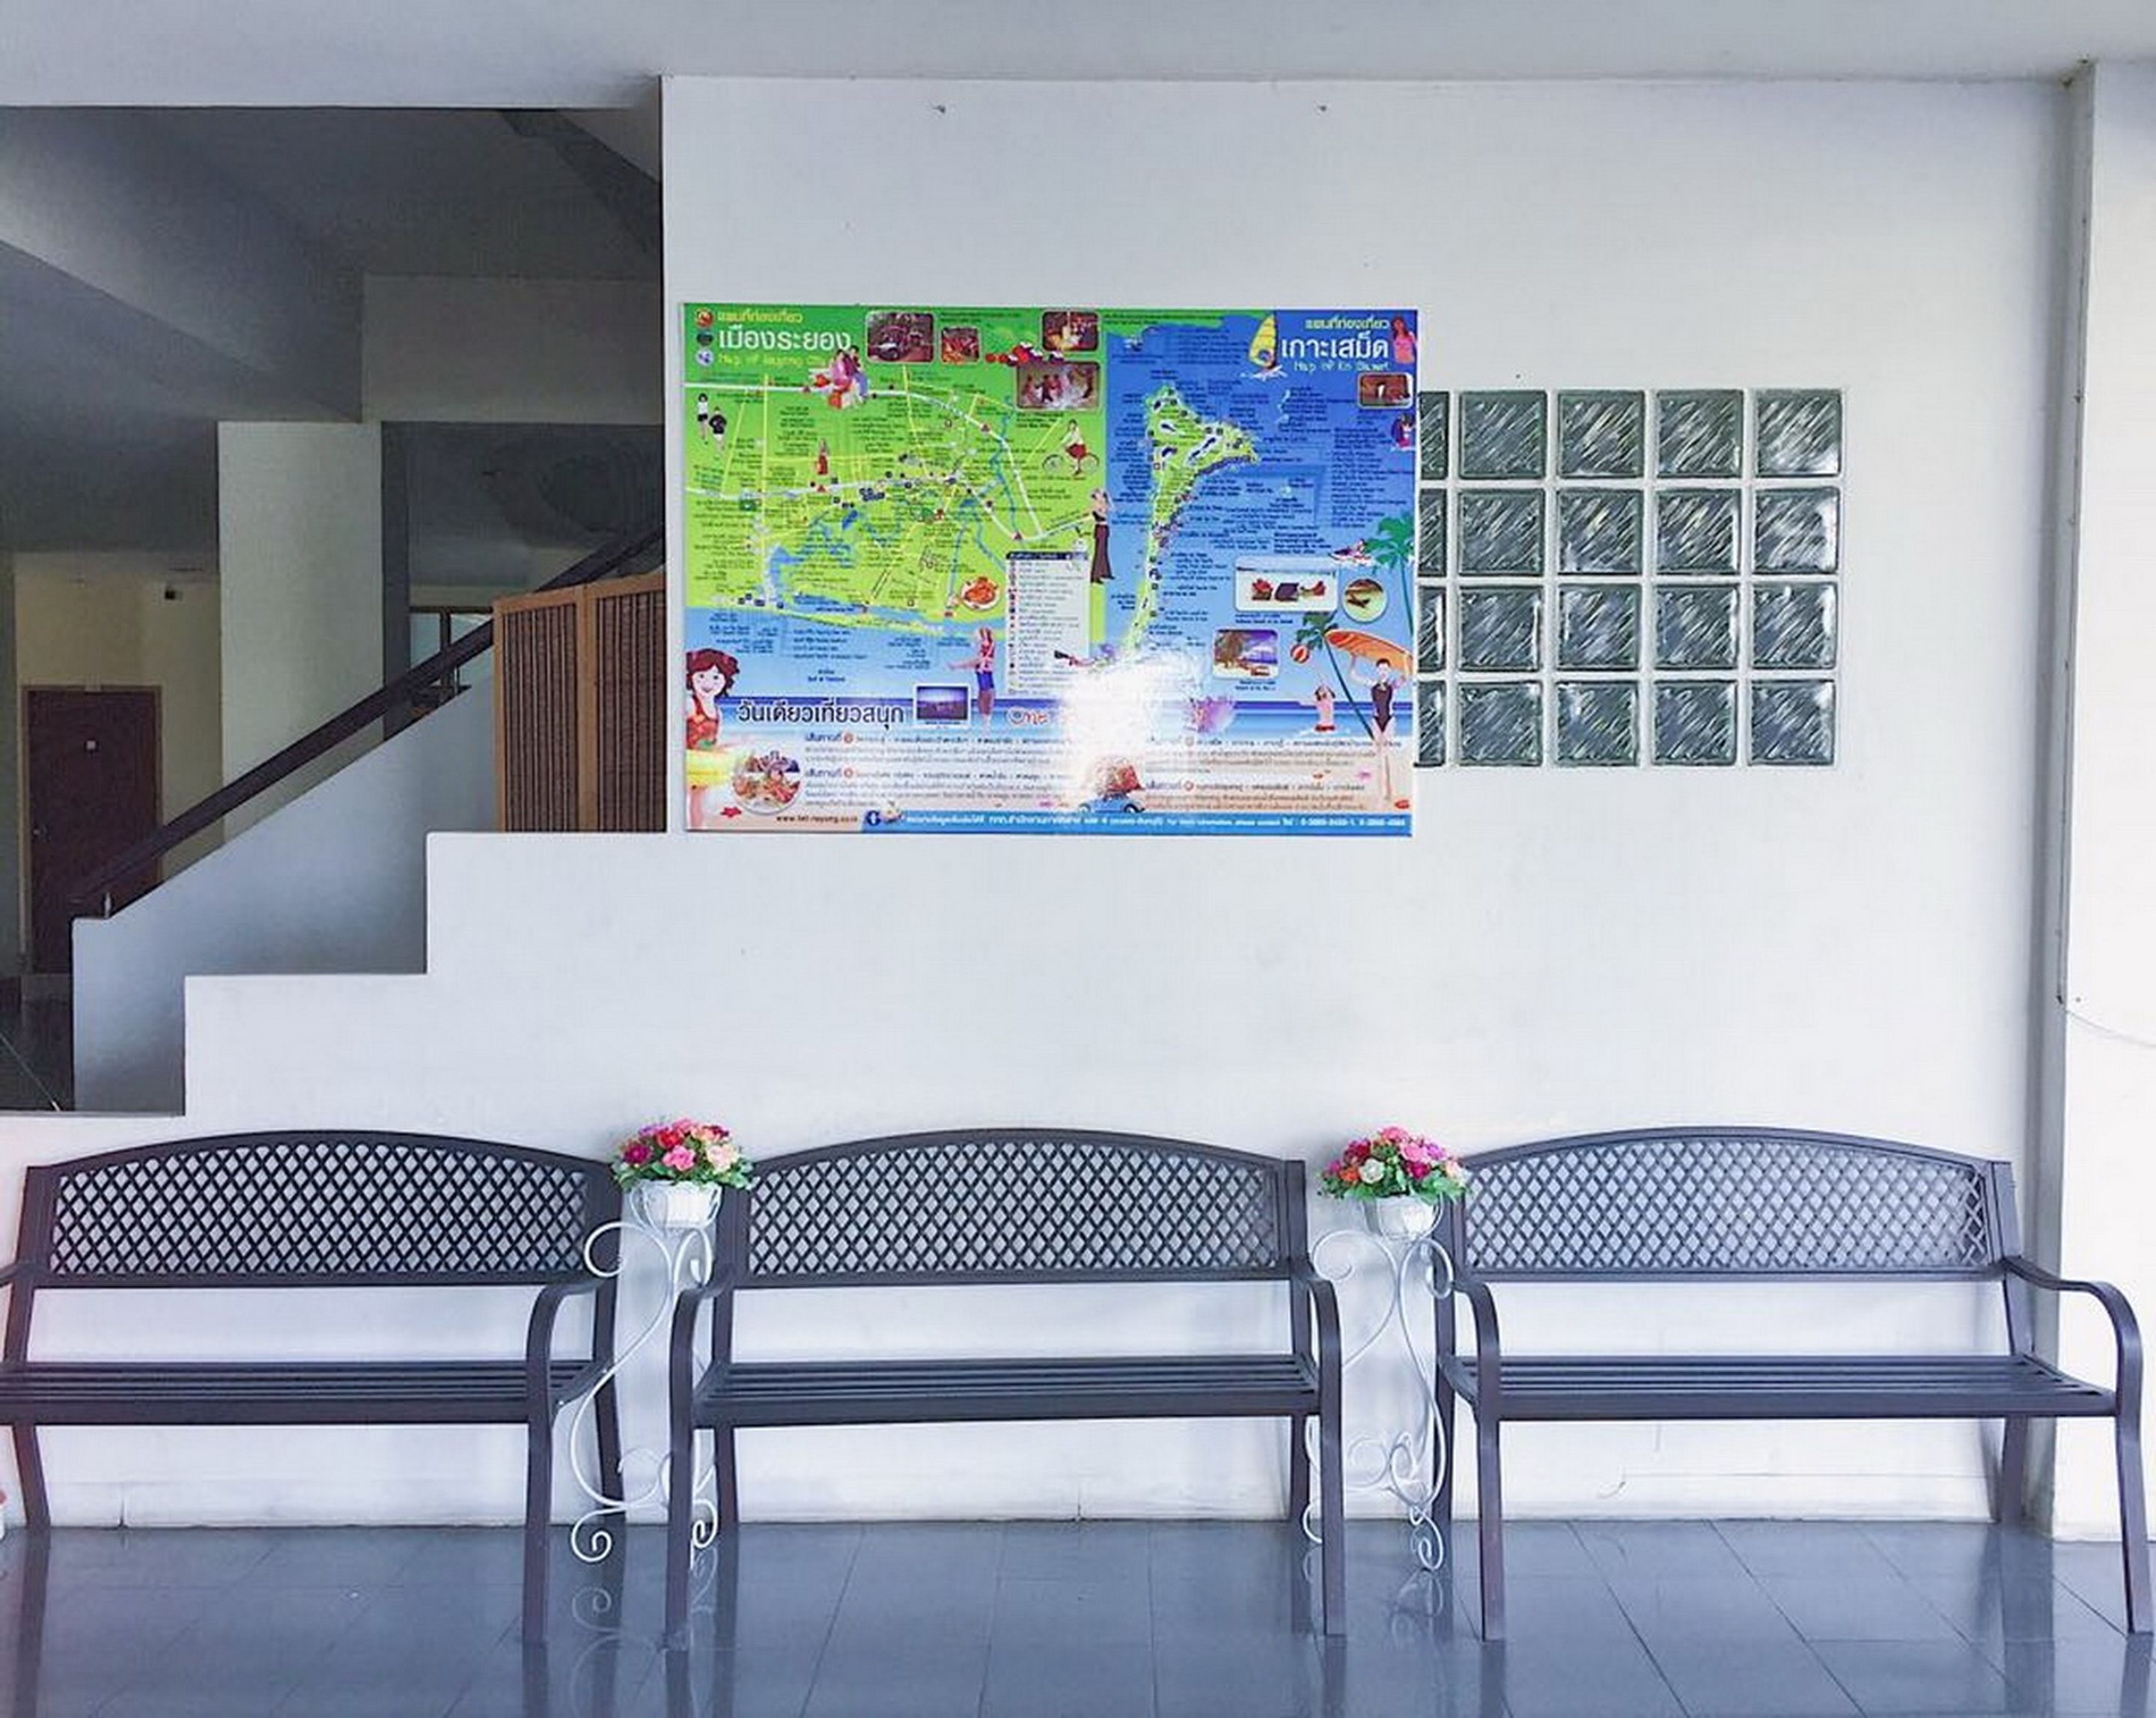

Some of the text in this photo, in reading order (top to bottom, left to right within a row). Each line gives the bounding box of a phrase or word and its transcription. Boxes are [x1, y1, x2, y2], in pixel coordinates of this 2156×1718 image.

[719, 324, 851, 350] เมืองระยอง
[1281, 331, 1389, 359] เกาะเสม็ด
[738, 698, 904, 731] วันเดียวเที่ยวสนุก
